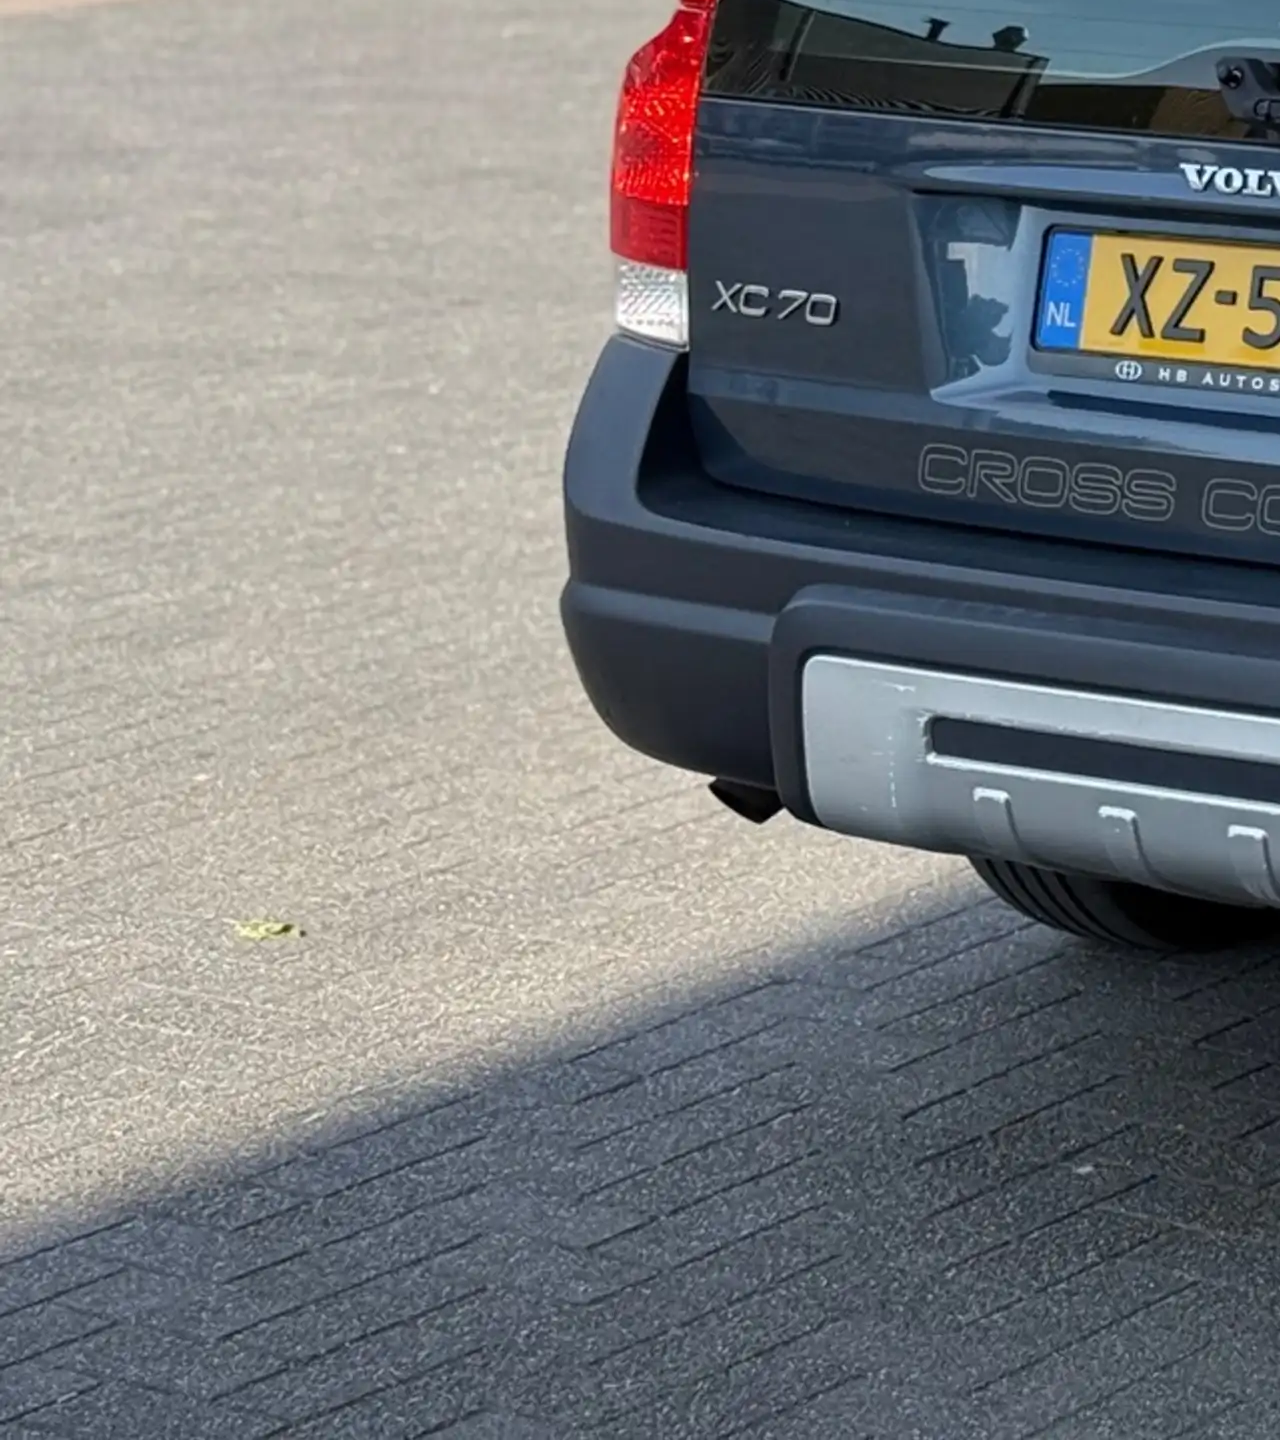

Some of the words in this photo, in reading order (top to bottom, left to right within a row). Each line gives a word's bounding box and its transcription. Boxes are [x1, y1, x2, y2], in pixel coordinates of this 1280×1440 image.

[1046, 301, 1076, 328] NL
[1158, 367, 1188, 383] HB
[918, 444, 1176, 522] CROSS
